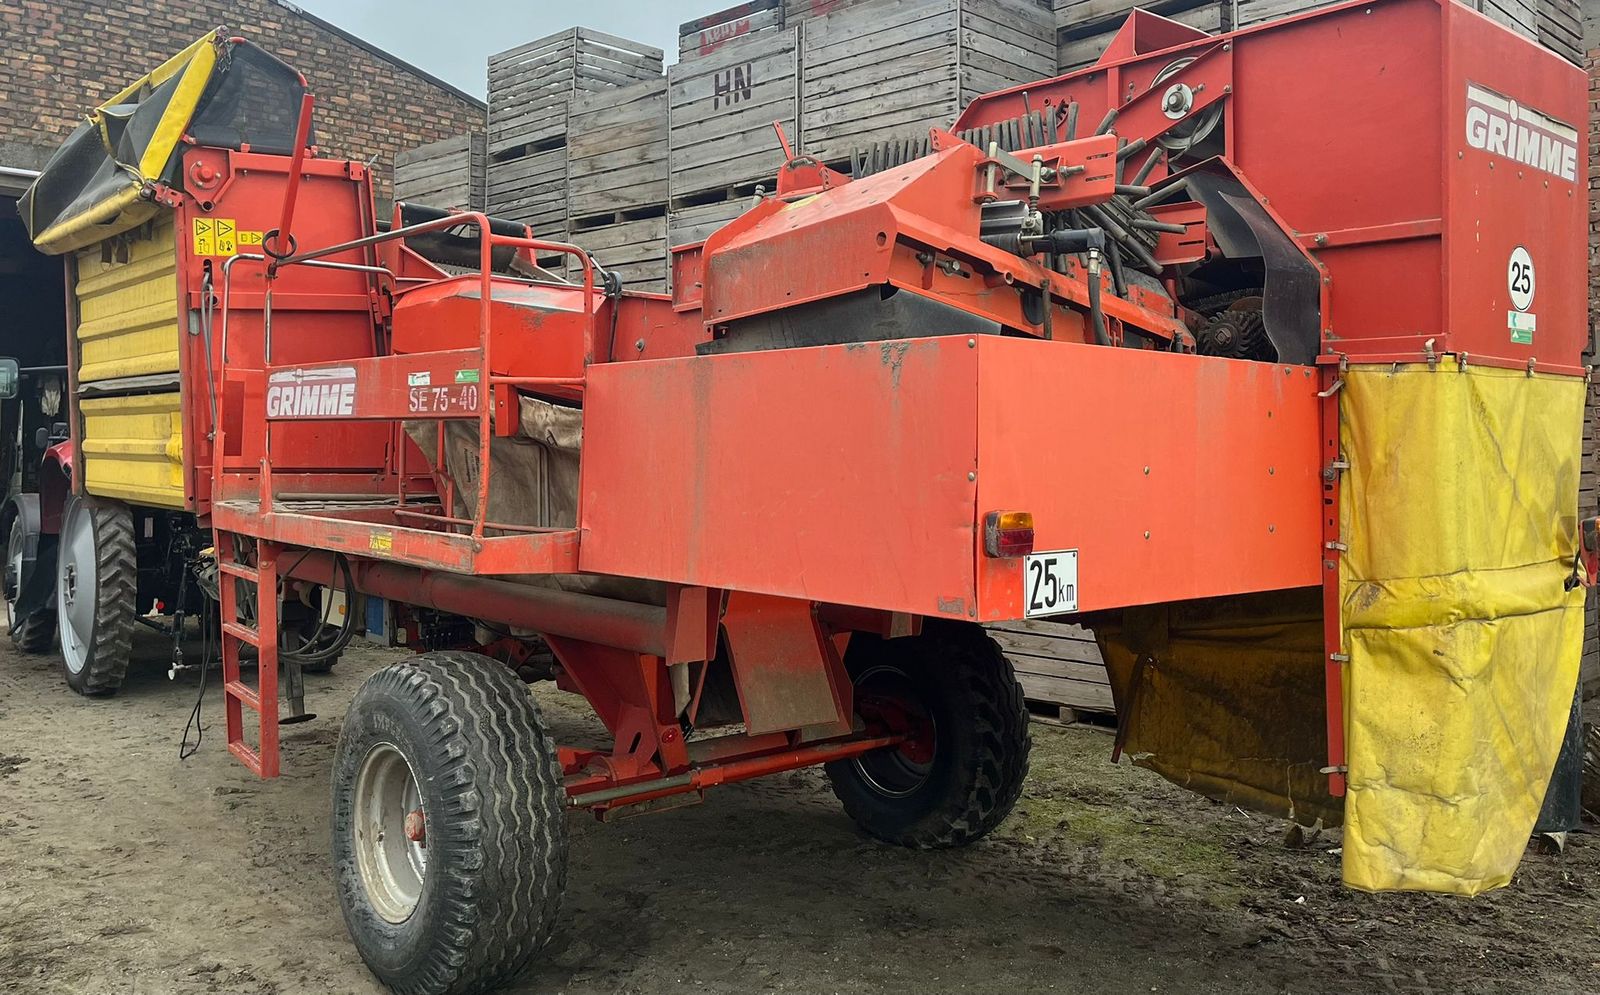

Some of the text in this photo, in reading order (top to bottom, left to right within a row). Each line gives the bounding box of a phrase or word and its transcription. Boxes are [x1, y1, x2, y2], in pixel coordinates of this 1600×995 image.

[714, 63, 752, 111] HN
[1466, 100, 1577, 182] GRIMME
[1511, 261, 1531, 294] 25
[267, 369, 355, 417] GRIMME
[408, 388, 429, 412] SE
[1030, 558, 1075, 610] 25 km
